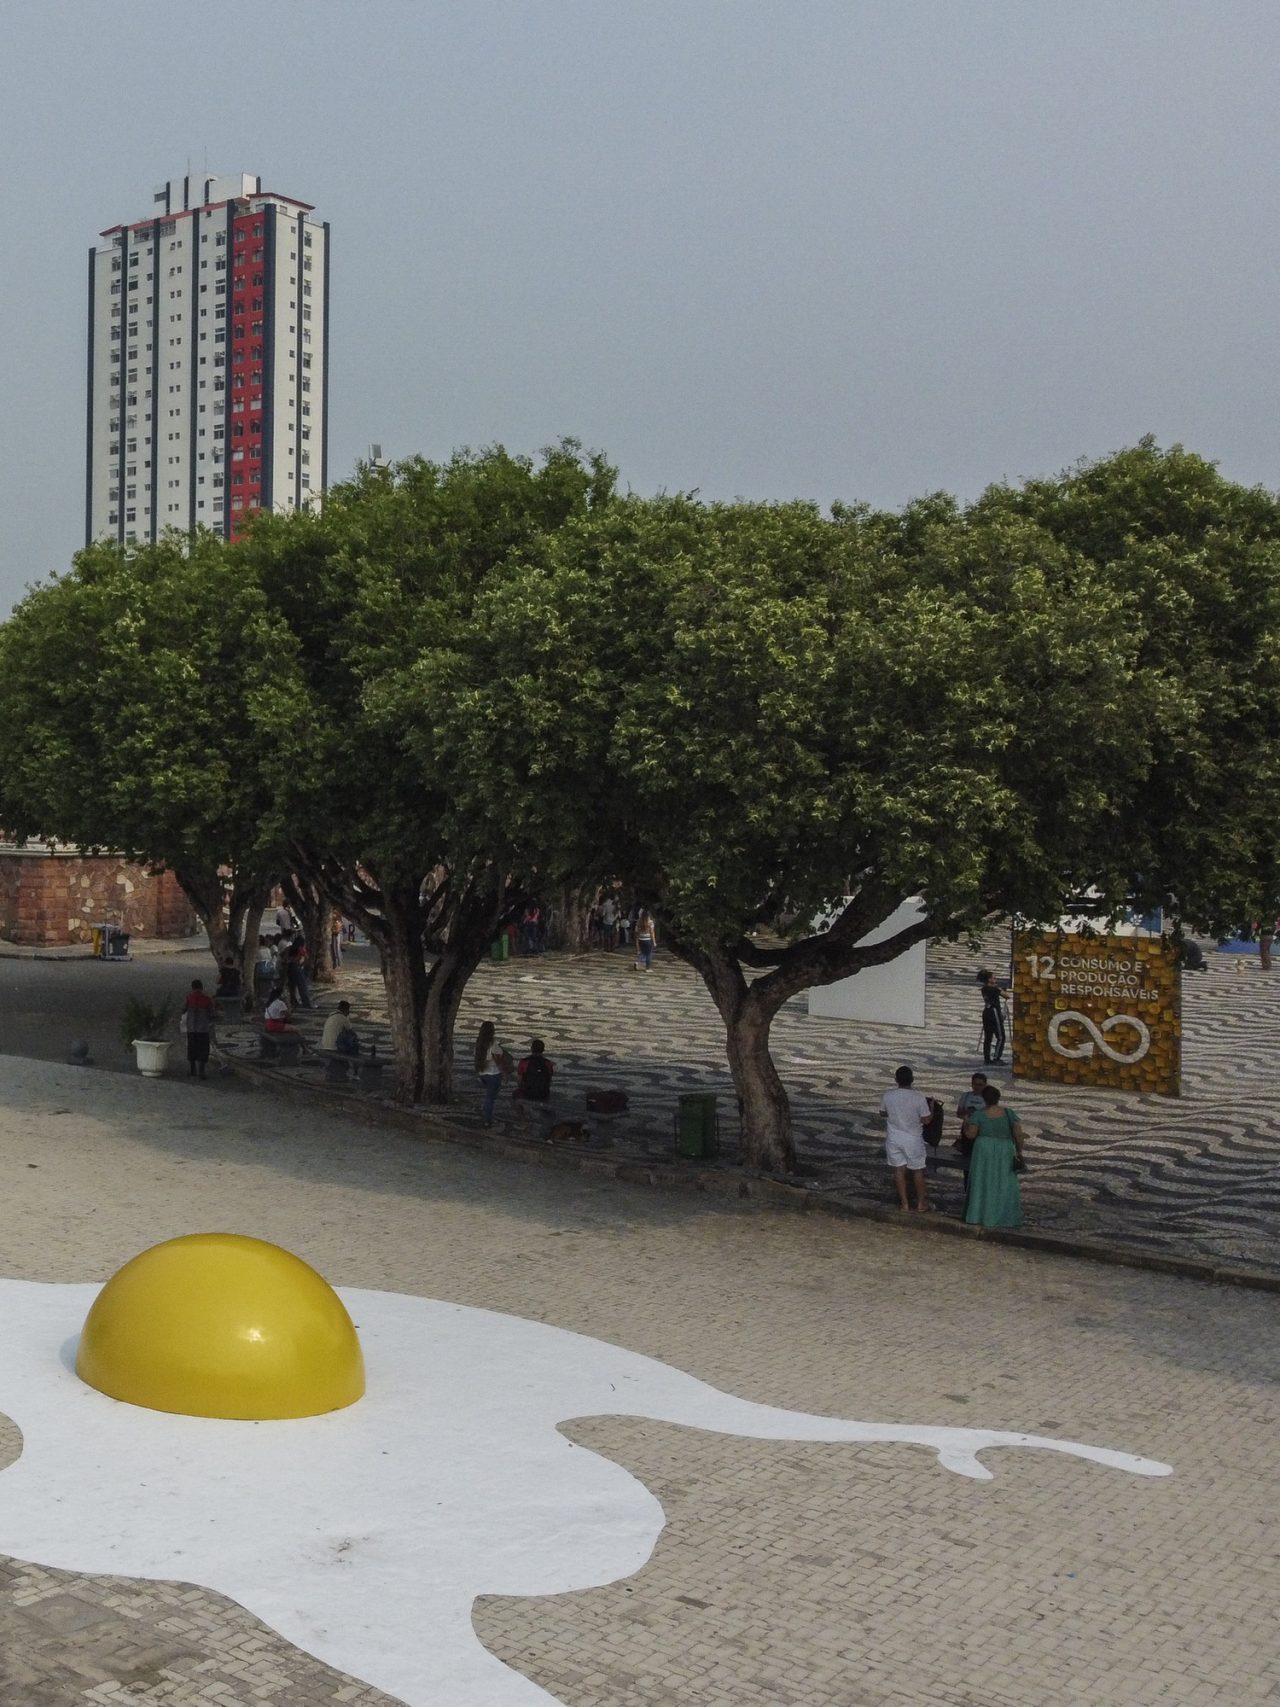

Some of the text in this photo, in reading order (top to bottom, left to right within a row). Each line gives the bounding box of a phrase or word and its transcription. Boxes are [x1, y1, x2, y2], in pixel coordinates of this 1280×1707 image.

[1026, 955, 1056, 979] 12
[1060, 956, 1143, 973] CONSUMO E
[1060, 970, 1138, 987] PRODUÇÃO
[1061, 984, 1159, 1000] RESPONSÁVEIS
